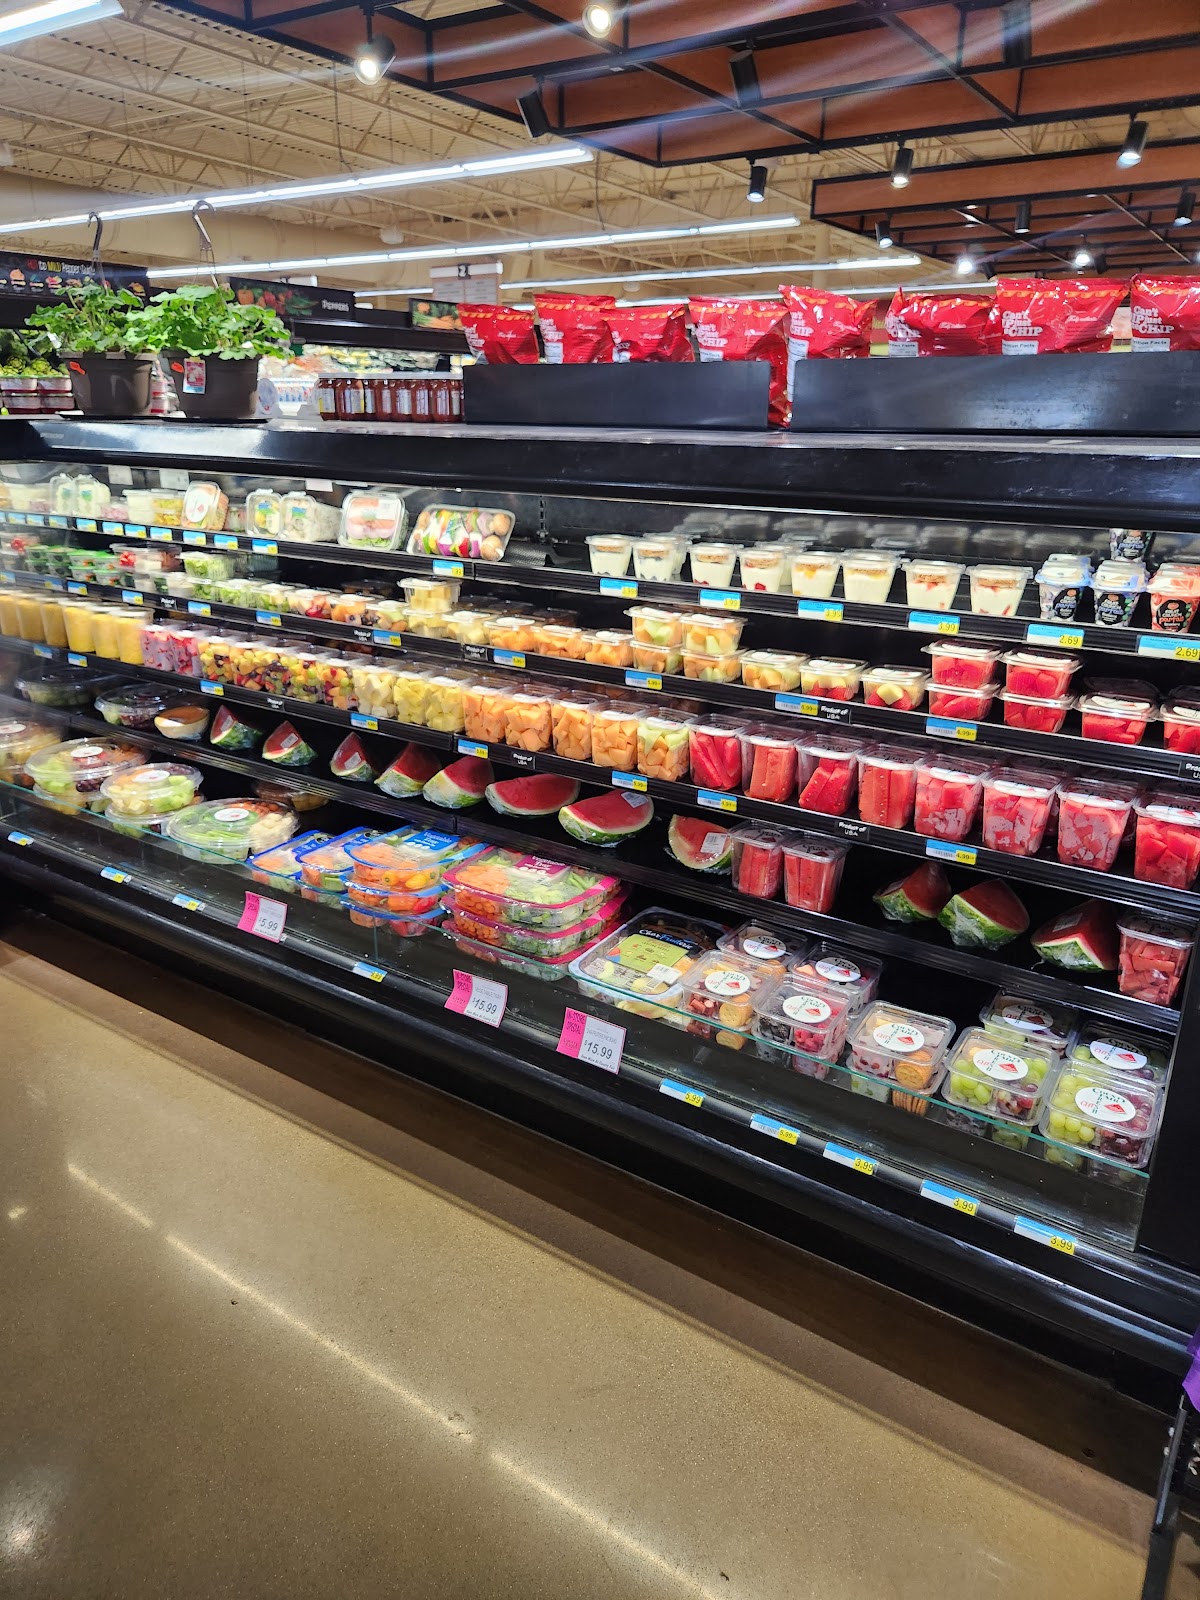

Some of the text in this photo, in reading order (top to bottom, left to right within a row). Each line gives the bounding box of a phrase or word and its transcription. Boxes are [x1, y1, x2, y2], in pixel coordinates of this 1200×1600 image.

[1002, 310, 1029, 319] Can't
[1133, 306, 1159, 317] Can't
[1008, 326, 1043, 337] CHIP
[1139, 323, 1175, 334] CHIP
[1060, 635, 1079, 646] 2.69
[1176, 647, 1199, 659] 2.69
[584, 1039, 613, 1060] $15.99
[855, 1159, 874, 1172] 3.99
[953, 1198, 974, 1212] 3.99
[1050, 1236, 1073, 1251] 3.99
